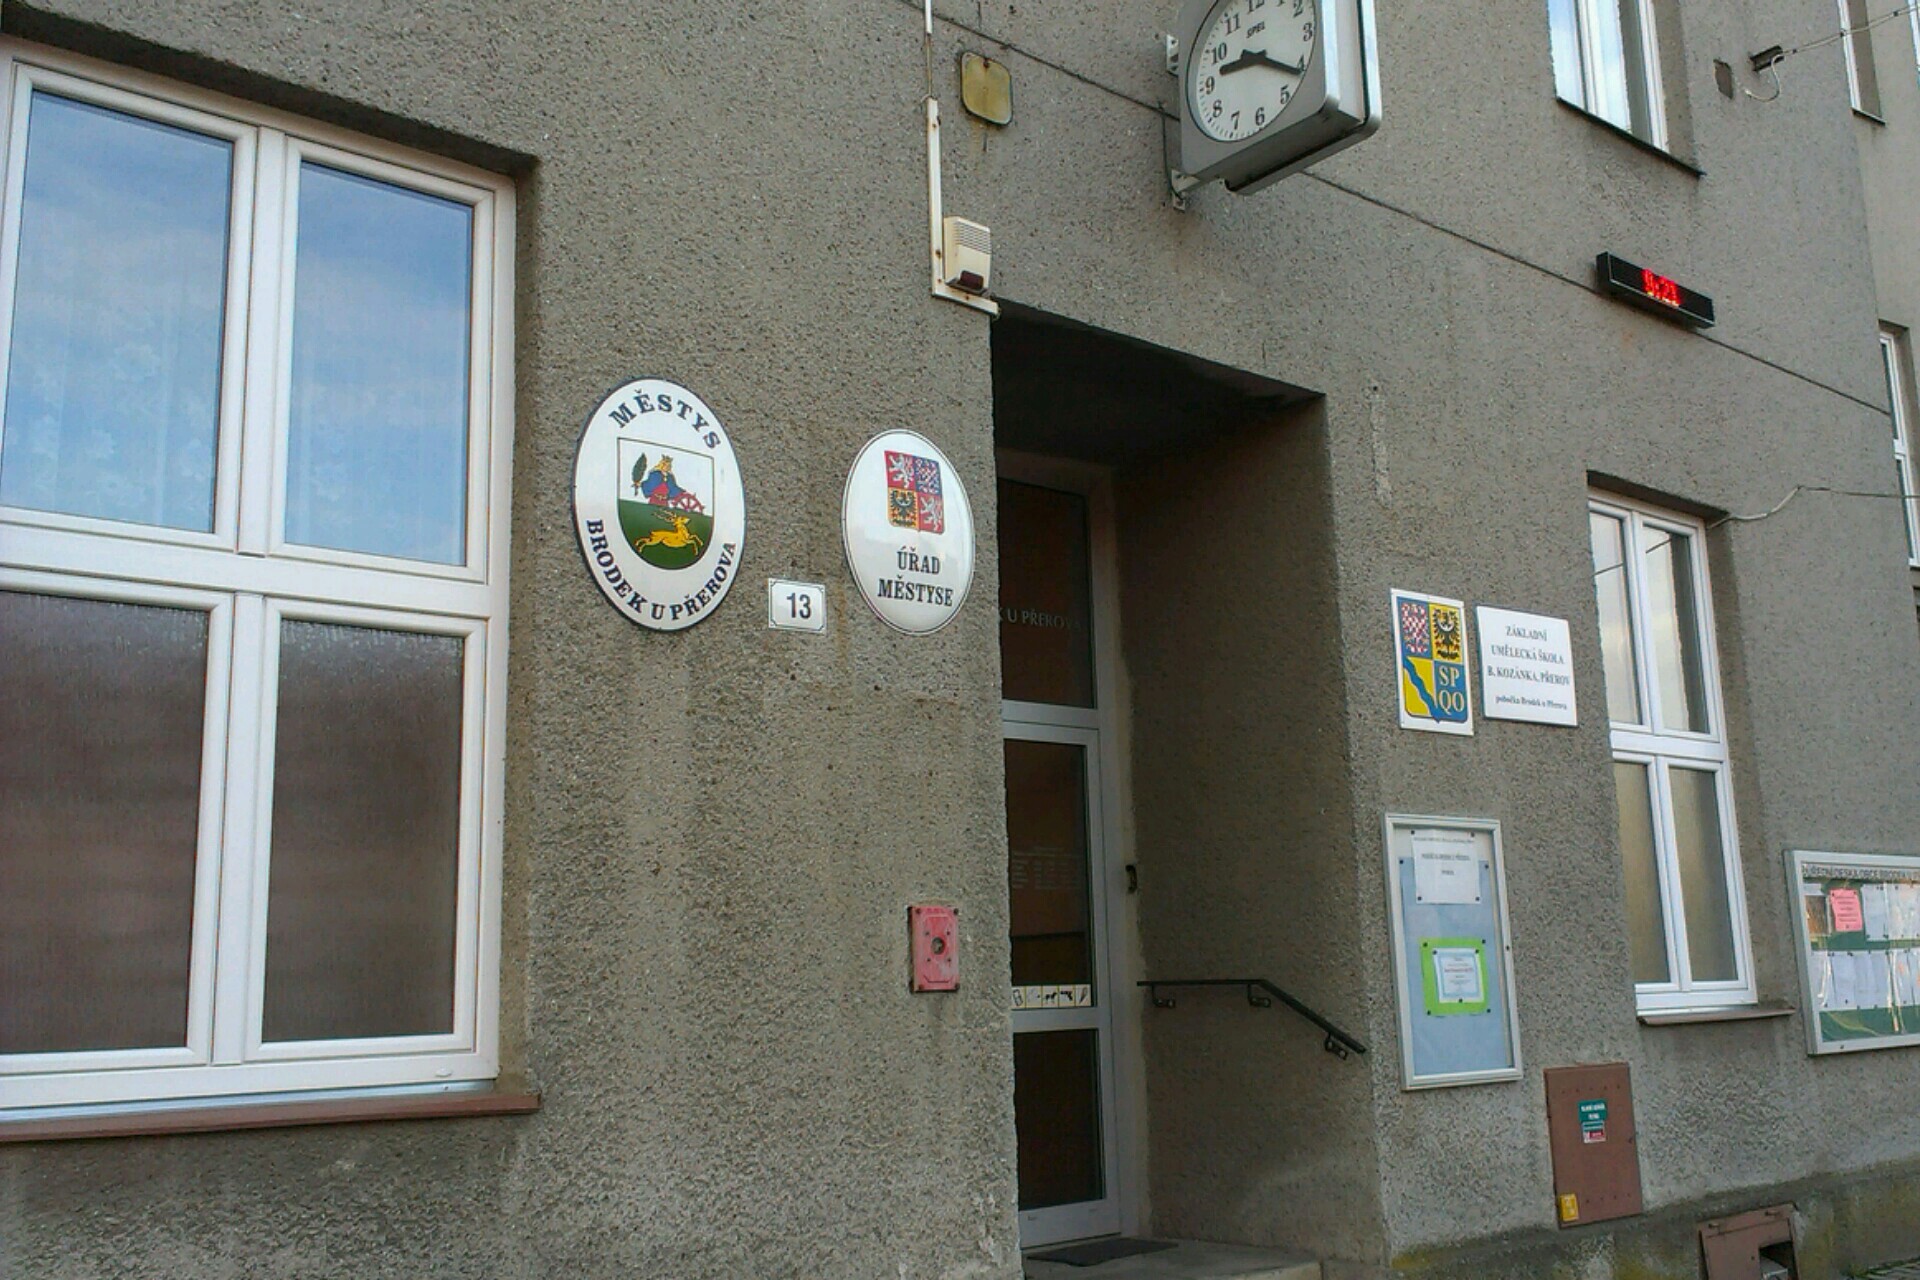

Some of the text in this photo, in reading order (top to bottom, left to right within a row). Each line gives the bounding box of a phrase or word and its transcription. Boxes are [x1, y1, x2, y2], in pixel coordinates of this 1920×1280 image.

[1293, 0, 1304, 17] 2
[1224, 13, 1241, 36] 11
[1303, 22, 1313, 41] 3
[1211, 42, 1228, 65] 10
[1205, 76, 1215, 95] 9
[1280, 84, 1290, 104] 5
[1212, 99, 1223, 118] 8
[1255, 107, 1265, 126] 6
[1231, 110, 1240, 130] 7
[608, 389, 721, 449] MĚSTYS
[586, 519, 737, 621] BRODEK U PŘEROVA
[897, 546, 941, 575] ÚŘAD
[877, 574, 954, 607] MĚSTYSE
[786, 592, 812, 619] 13
[1506, 624, 1547, 641] ZÁKLADNÍ
[1491, 644, 1565, 664] UMĚLECKÁ ŠKOLA
[1439, 665, 1460, 687] SP
[1439, 689, 1465, 716] QO
